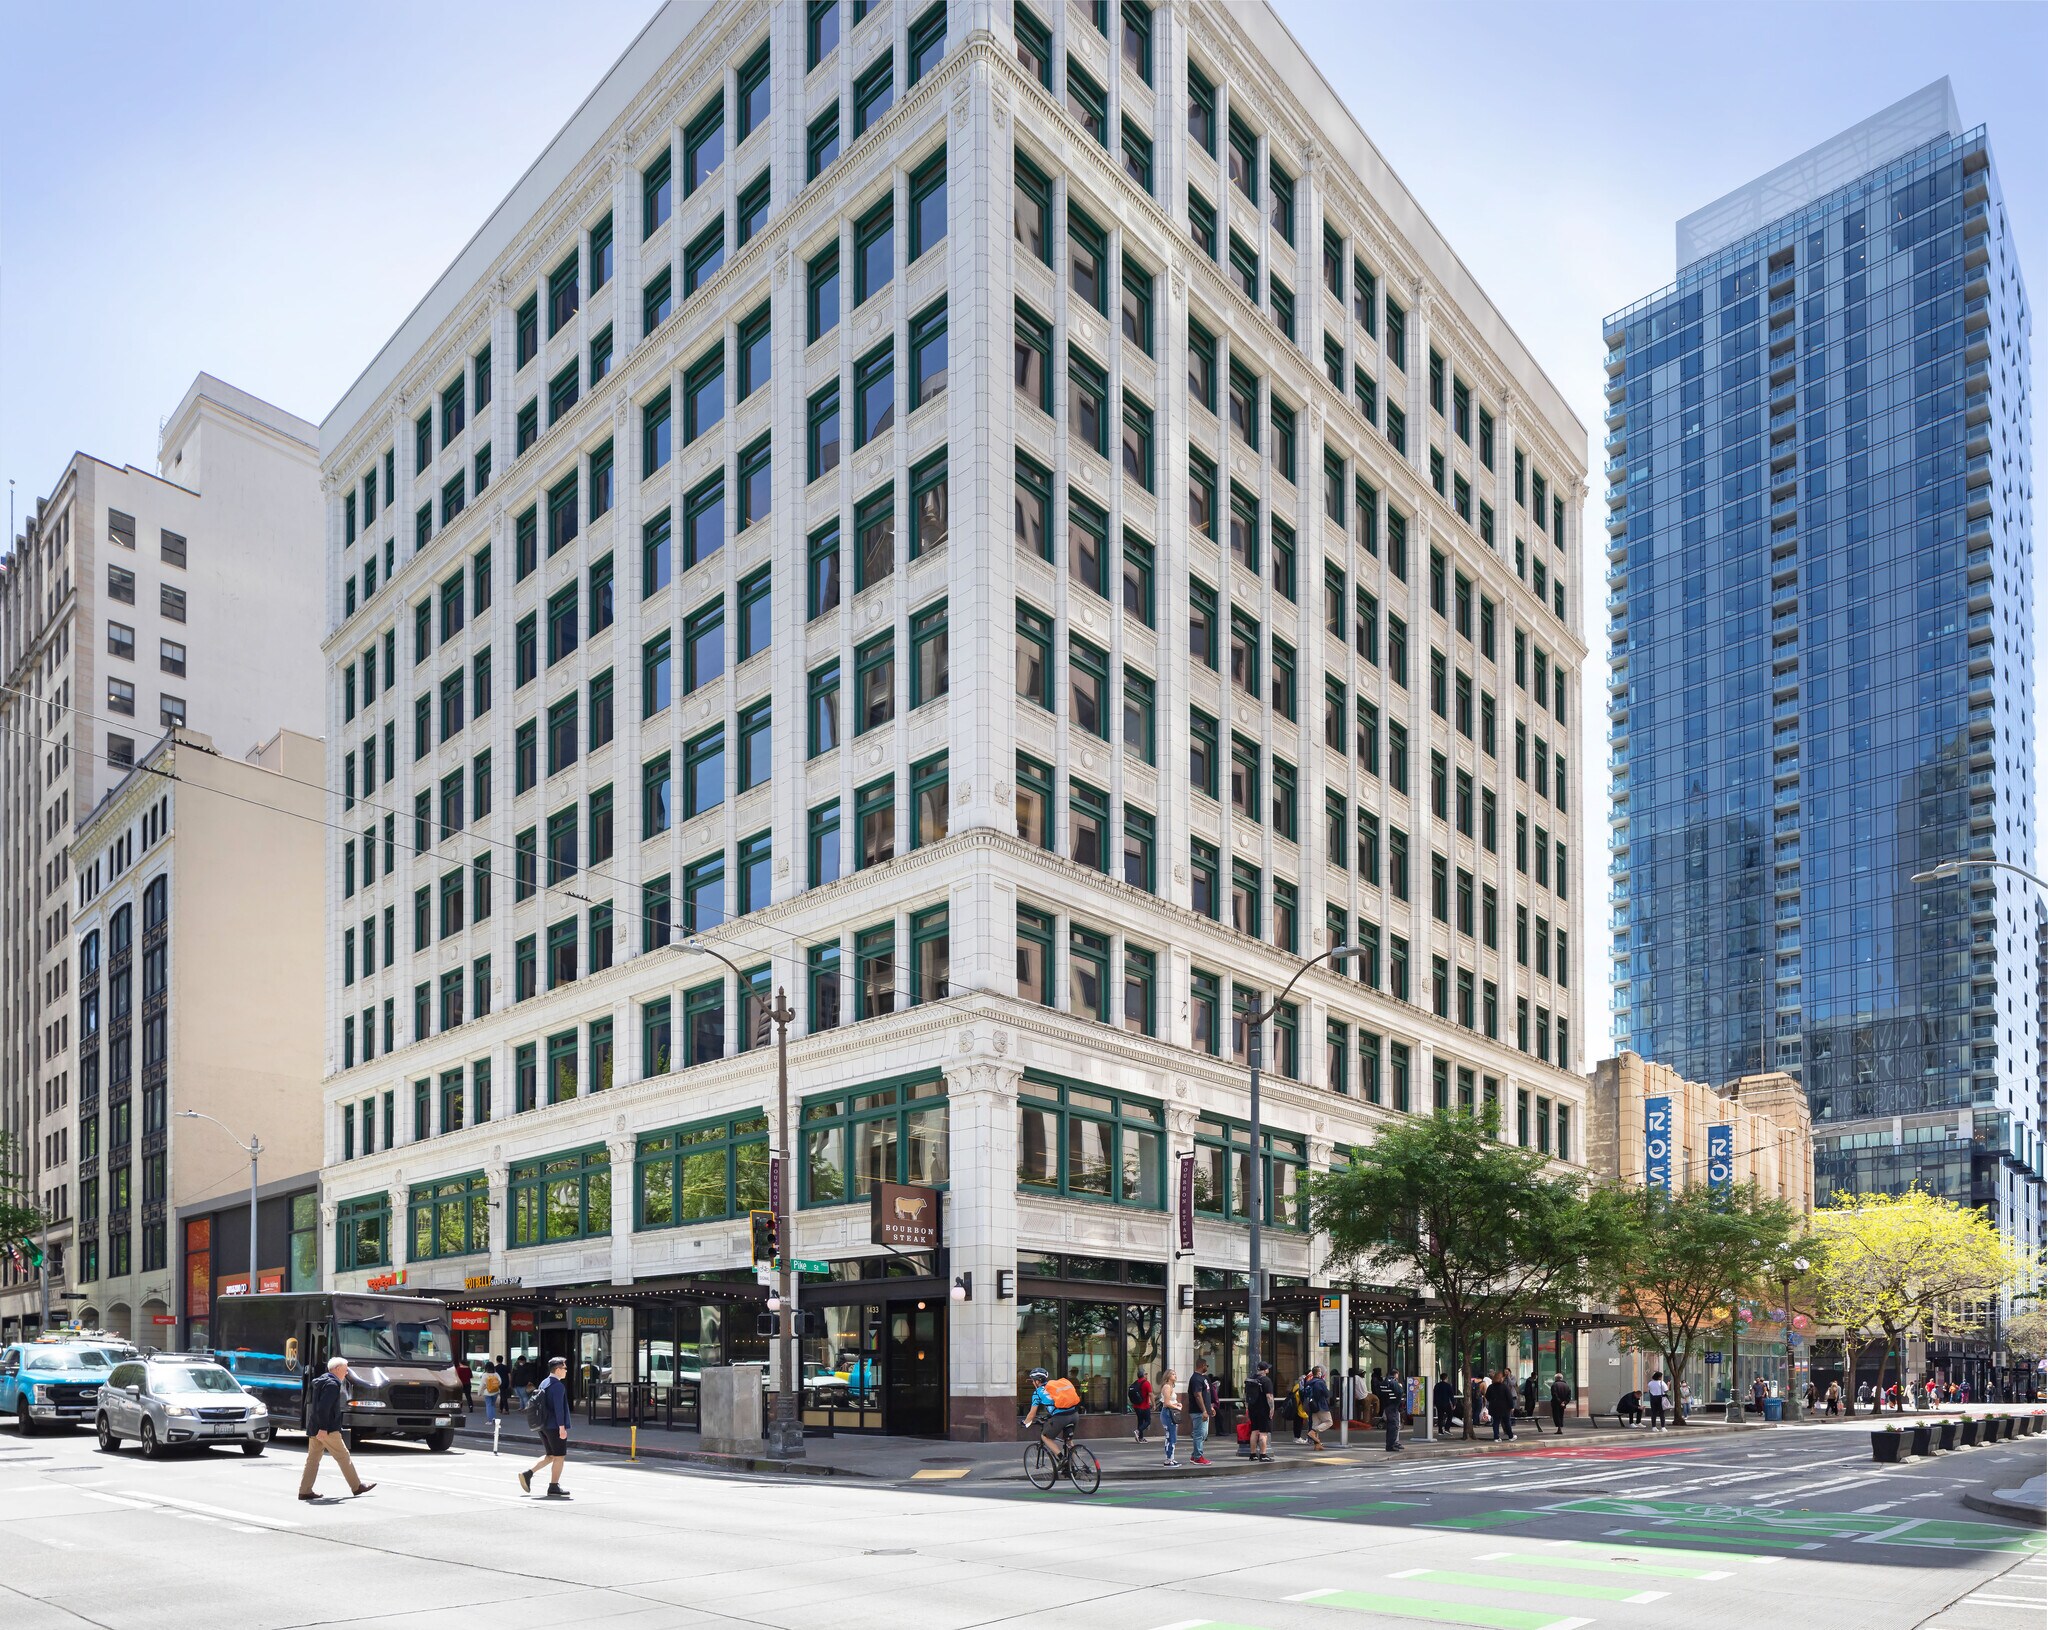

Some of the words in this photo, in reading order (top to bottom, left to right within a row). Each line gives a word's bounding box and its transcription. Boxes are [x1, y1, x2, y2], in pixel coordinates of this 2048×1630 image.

[1648, 1111, 1667, 1187] ROS
[885, 1224, 934, 1235] BOURBON
[893, 1233, 926, 1243] STEAK
[793, 1260, 807, 1270] Pike
[465, 1275, 492, 1288] POTBELLY
[453, 1317, 482, 1325] veggiegrill
